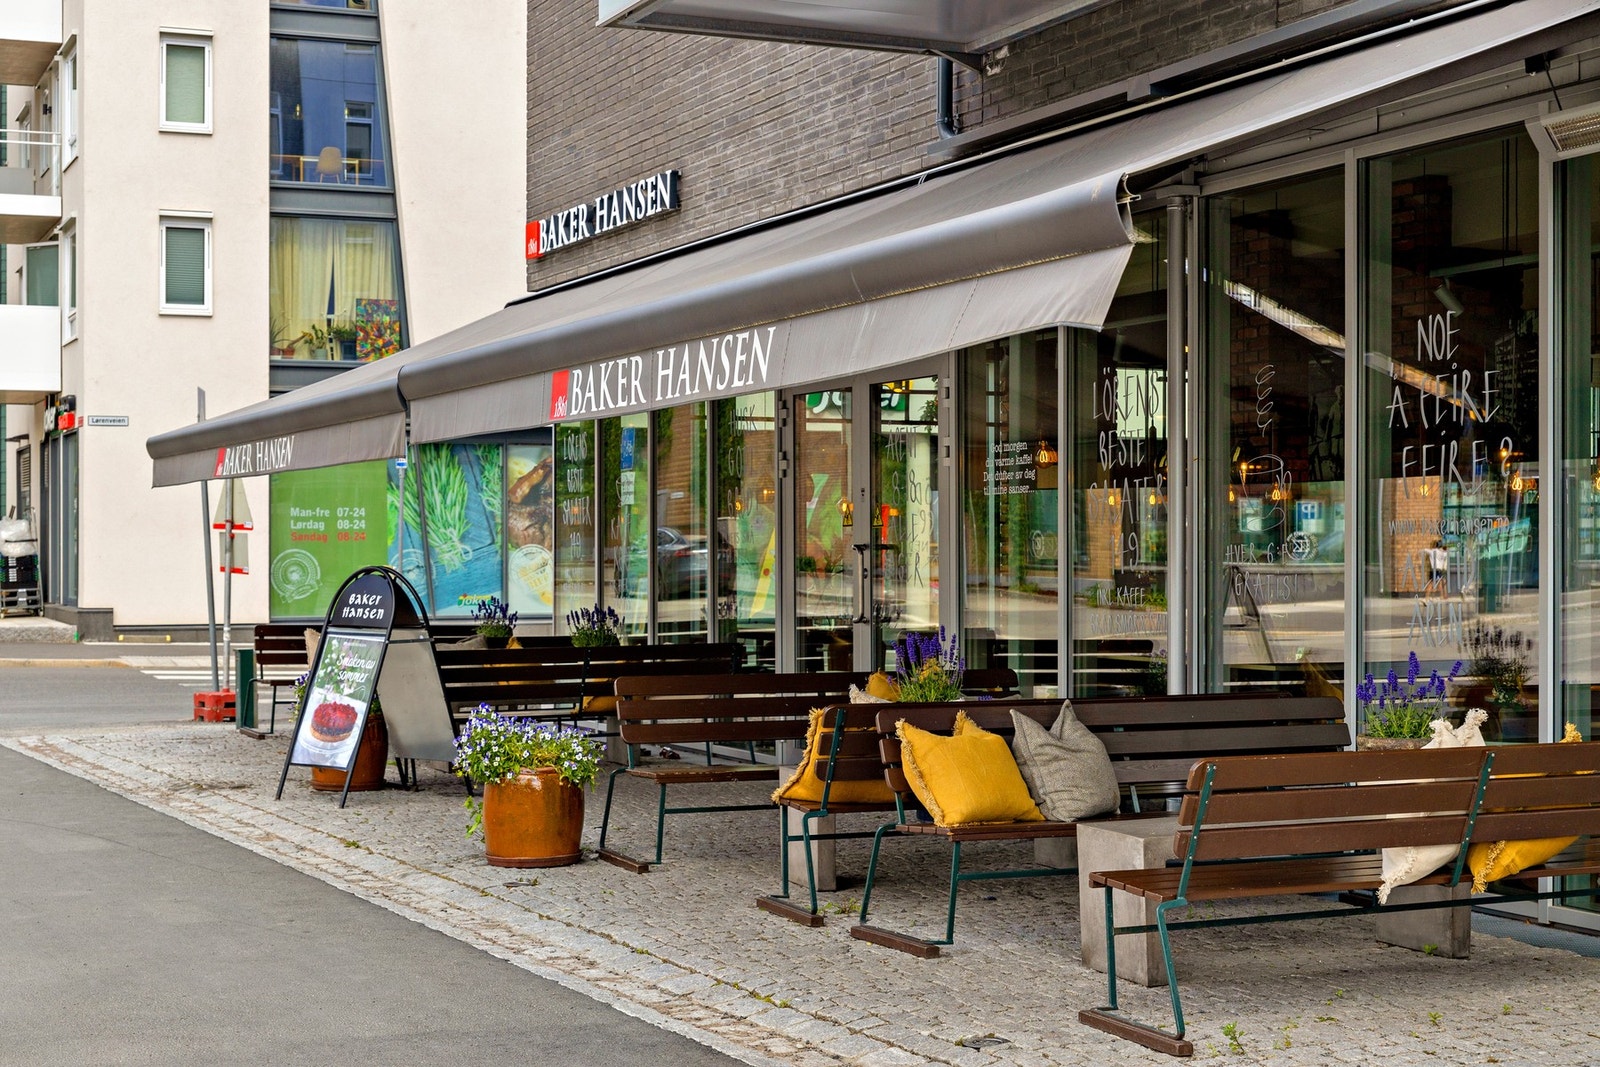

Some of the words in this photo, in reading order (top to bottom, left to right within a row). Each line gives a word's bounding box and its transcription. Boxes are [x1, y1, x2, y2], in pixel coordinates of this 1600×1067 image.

[539, 203, 590, 254] BAKER
[595, 169, 672, 235] HANSEN
[1417, 310, 1460, 361] NOE
[570, 355, 646, 416] BAKER
[655, 326, 776, 401] HANSEN
[1386, 375, 1410, 428] Å
[223, 444, 252, 475] BAKER
[256, 435, 294, 471] HANSEN
[1100, 429, 1144, 471] BESTE
[290, 507, 330, 518] Man-fre
[336, 507, 366, 518] 07-24
[290, 520, 325, 531] Lørdag
[337, 520, 366, 530] 08-24
[291, 531, 328, 543] Søndag
[337, 531, 366, 541] 08-24
[1225, 542, 1257, 564] HVER
